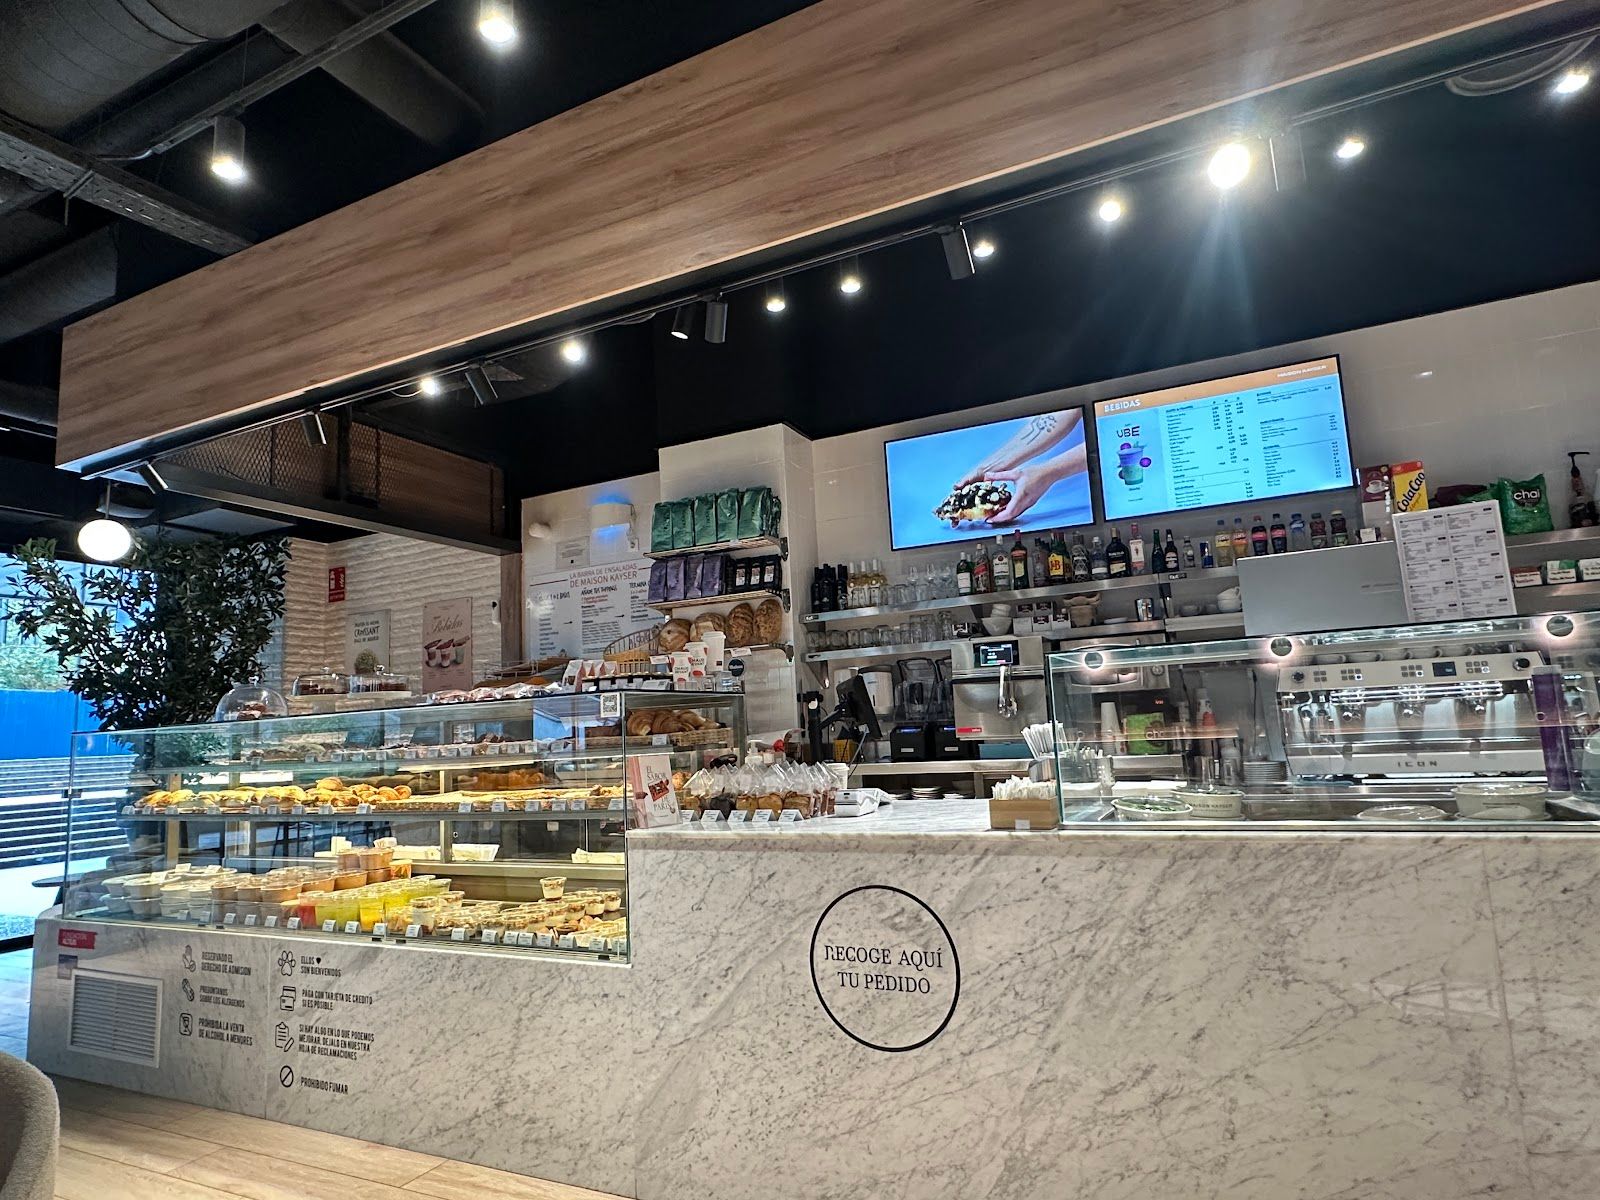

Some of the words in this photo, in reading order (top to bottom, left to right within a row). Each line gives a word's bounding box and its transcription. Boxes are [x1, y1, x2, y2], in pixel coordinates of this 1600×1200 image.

[1104, 399, 1141, 412] BEBIDAS
[1397, 472, 1426, 513] ColaCao
[570, 580, 580, 589] DE
[581, 575, 609, 586] MAISON
[610, 570, 639, 582] KAYSER
[1397, 760, 1438, 768] ICON
[301, 955, 315, 966] ELLOS
[825, 945, 892, 965] RECOGE
[898, 947, 943, 972] AQUÍ
[301, 966, 310, 975] SON
[311, 967, 341, 978] BIENVENIDOS
[838, 971, 860, 989] TU
[864, 973, 931, 995] PEDIDO
[302, 989, 314, 999] PAGA
[325, 991, 344, 1002] TARJETA
[345, 993, 352, 1003] DE
[307, 999, 313, 1009] ES
[314, 1000, 333, 1011] POSIBLE
[230, 1022, 245, 1033] VENTA
[199, 1028, 205, 1039] DE
[230, 1034, 253, 1046] MENORES
[341, 1029, 351, 1040] QUE
[351, 1031, 375, 1042] PODEMOS
[348, 1040, 371, 1052] NUESTRA
[318, 1046, 358, 1061] RECLAMACIONES
[301, 1076, 329, 1091] PROHIBIDO
[329, 1080, 349, 1095] FUMAR
